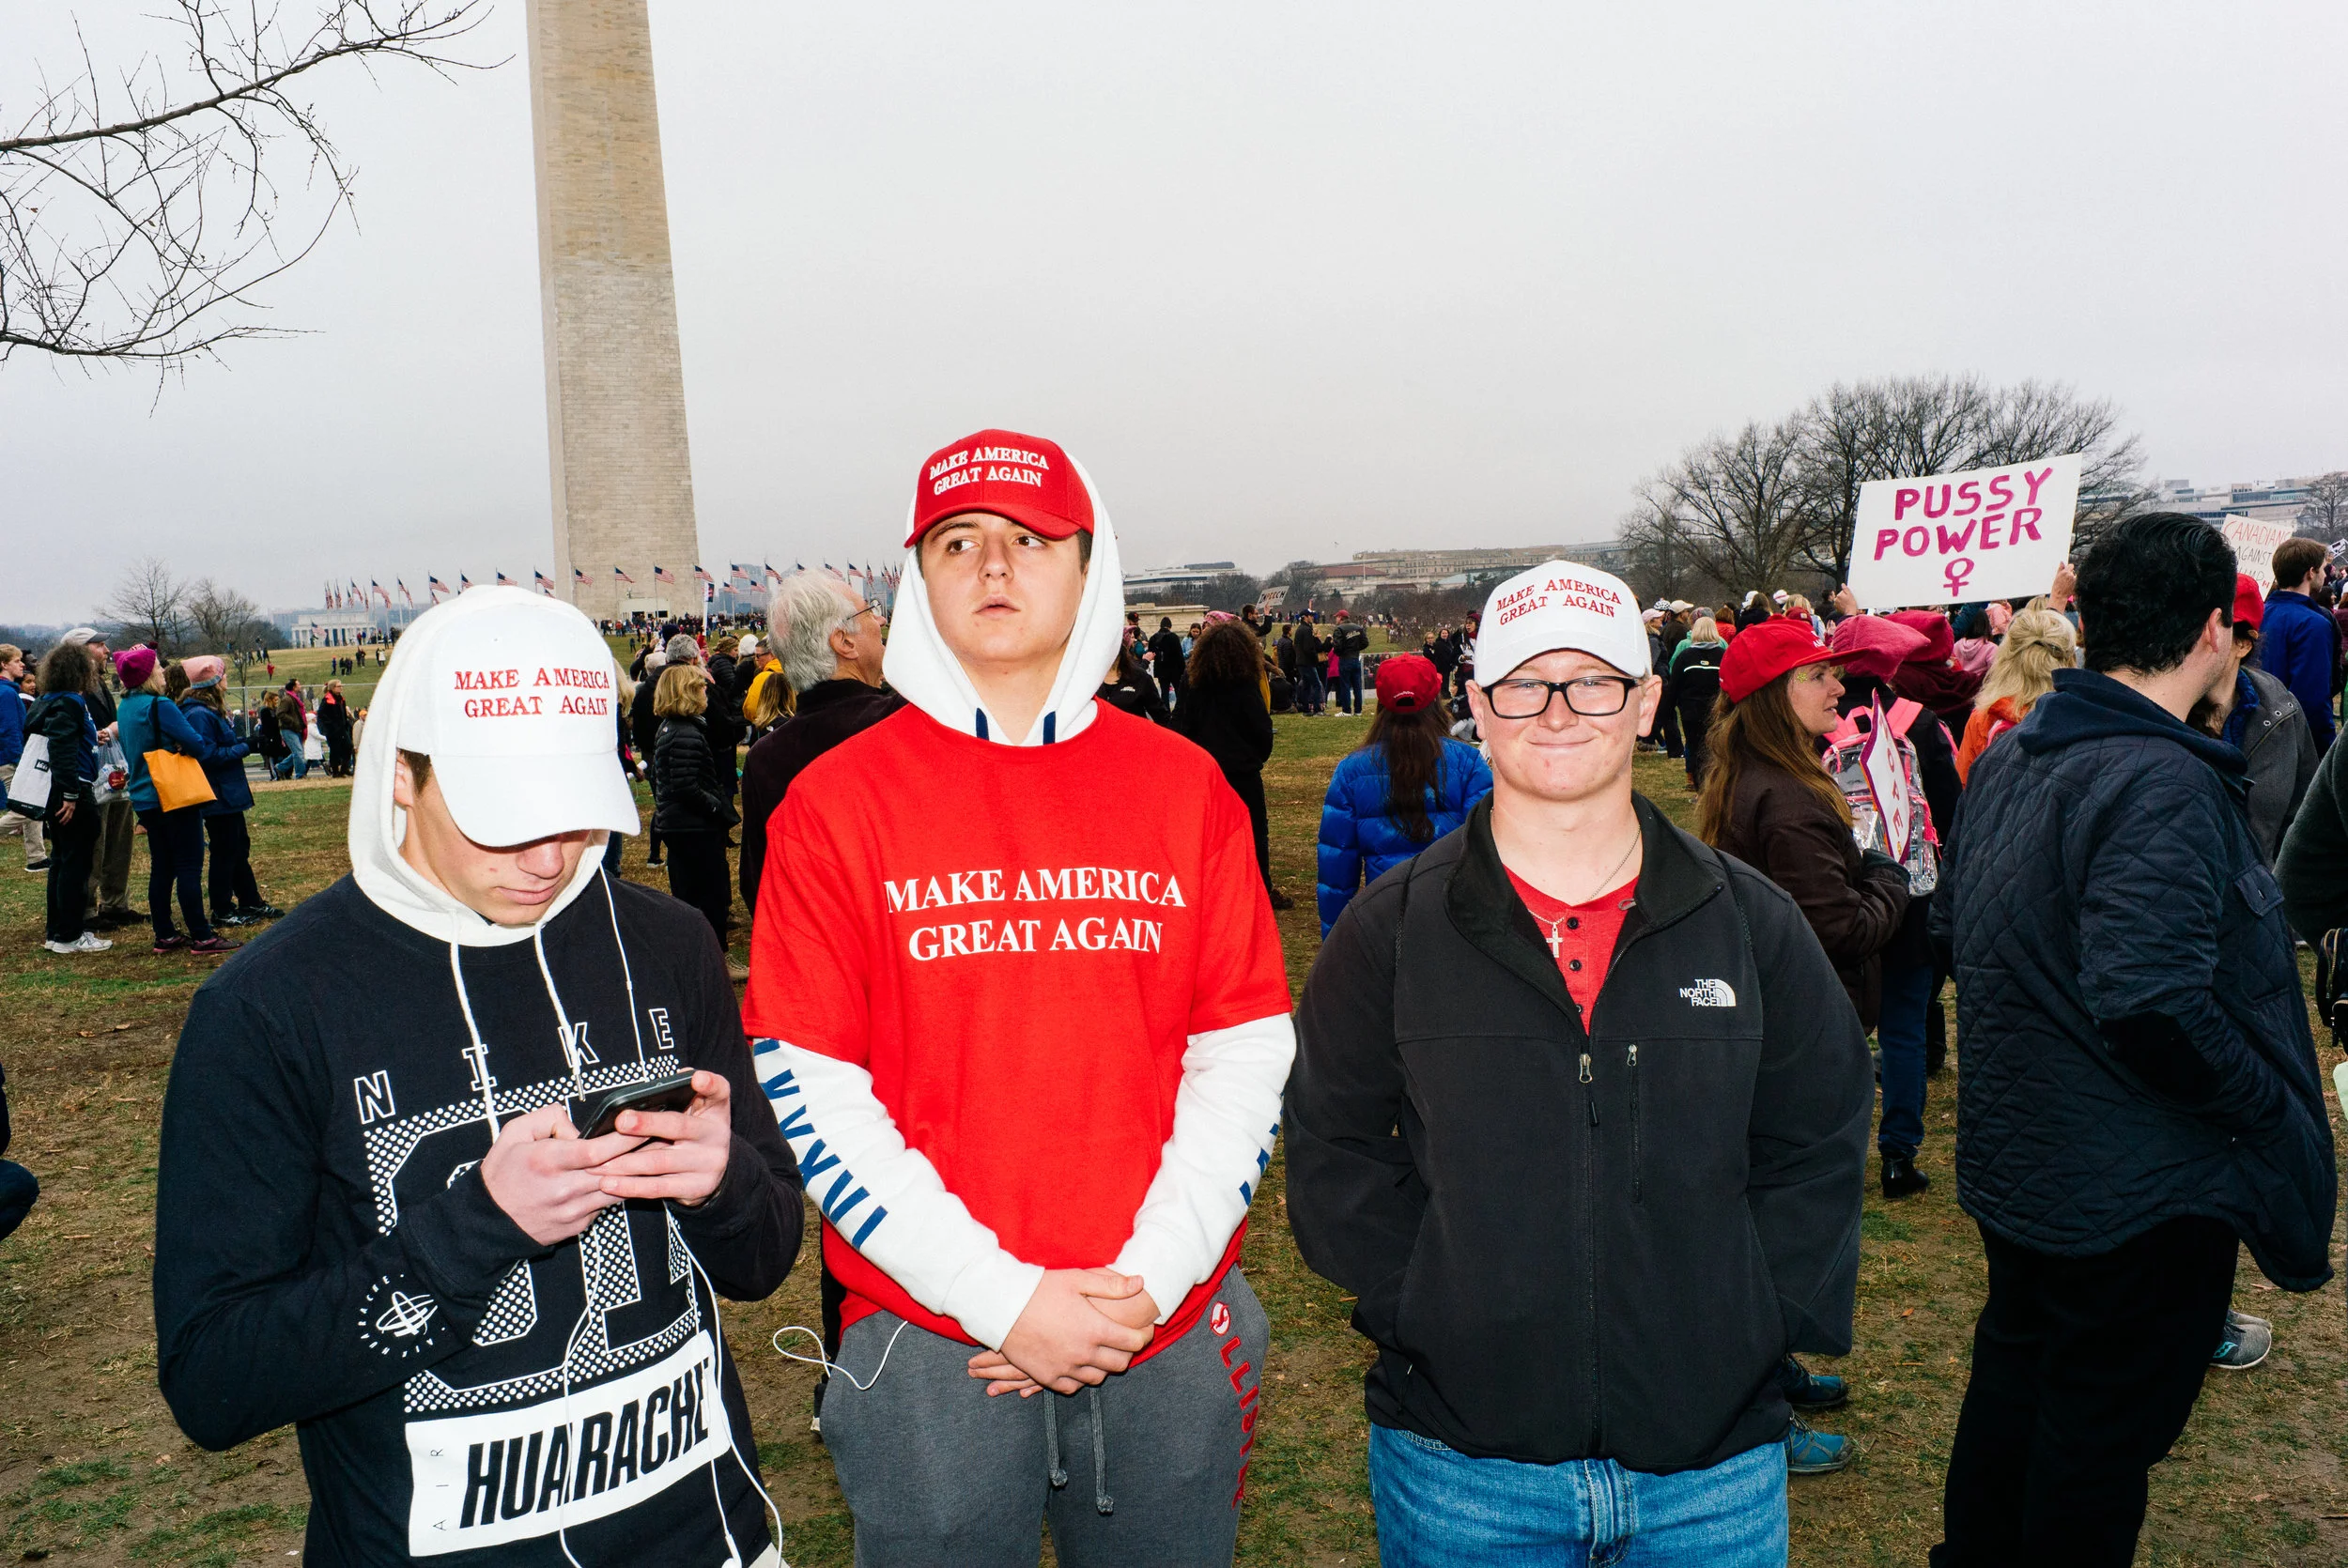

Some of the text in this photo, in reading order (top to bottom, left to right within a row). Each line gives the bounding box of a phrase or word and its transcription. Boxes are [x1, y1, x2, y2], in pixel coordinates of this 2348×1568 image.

[929, 447, 1049, 481] MAKE AMERICA
[934, 466, 1043, 496] GREAT AGAIN
[1894, 467, 2053, 521] PUSSY
[1874, 507, 2043, 561] POWER
[1495, 578, 1622, 612] MAKE AMERICA
[1499, 594, 1614, 625] GREAT AGAIN
[455, 668, 610, 690] MAKE AMERICA
[465, 695, 608, 718] GREAT AGAIN
[884, 867, 1187, 914] MAKE AMERICA
[908, 916, 1163, 961] GREAT AGAIN
[1679, 988, 1716, 997] NORTH
[1694, 978, 1715, 989] THE
[1691, 997, 1718, 1007] FACE
[353, 1007, 674, 1126] NIKE
[429, 1448, 450, 1531] AIR
